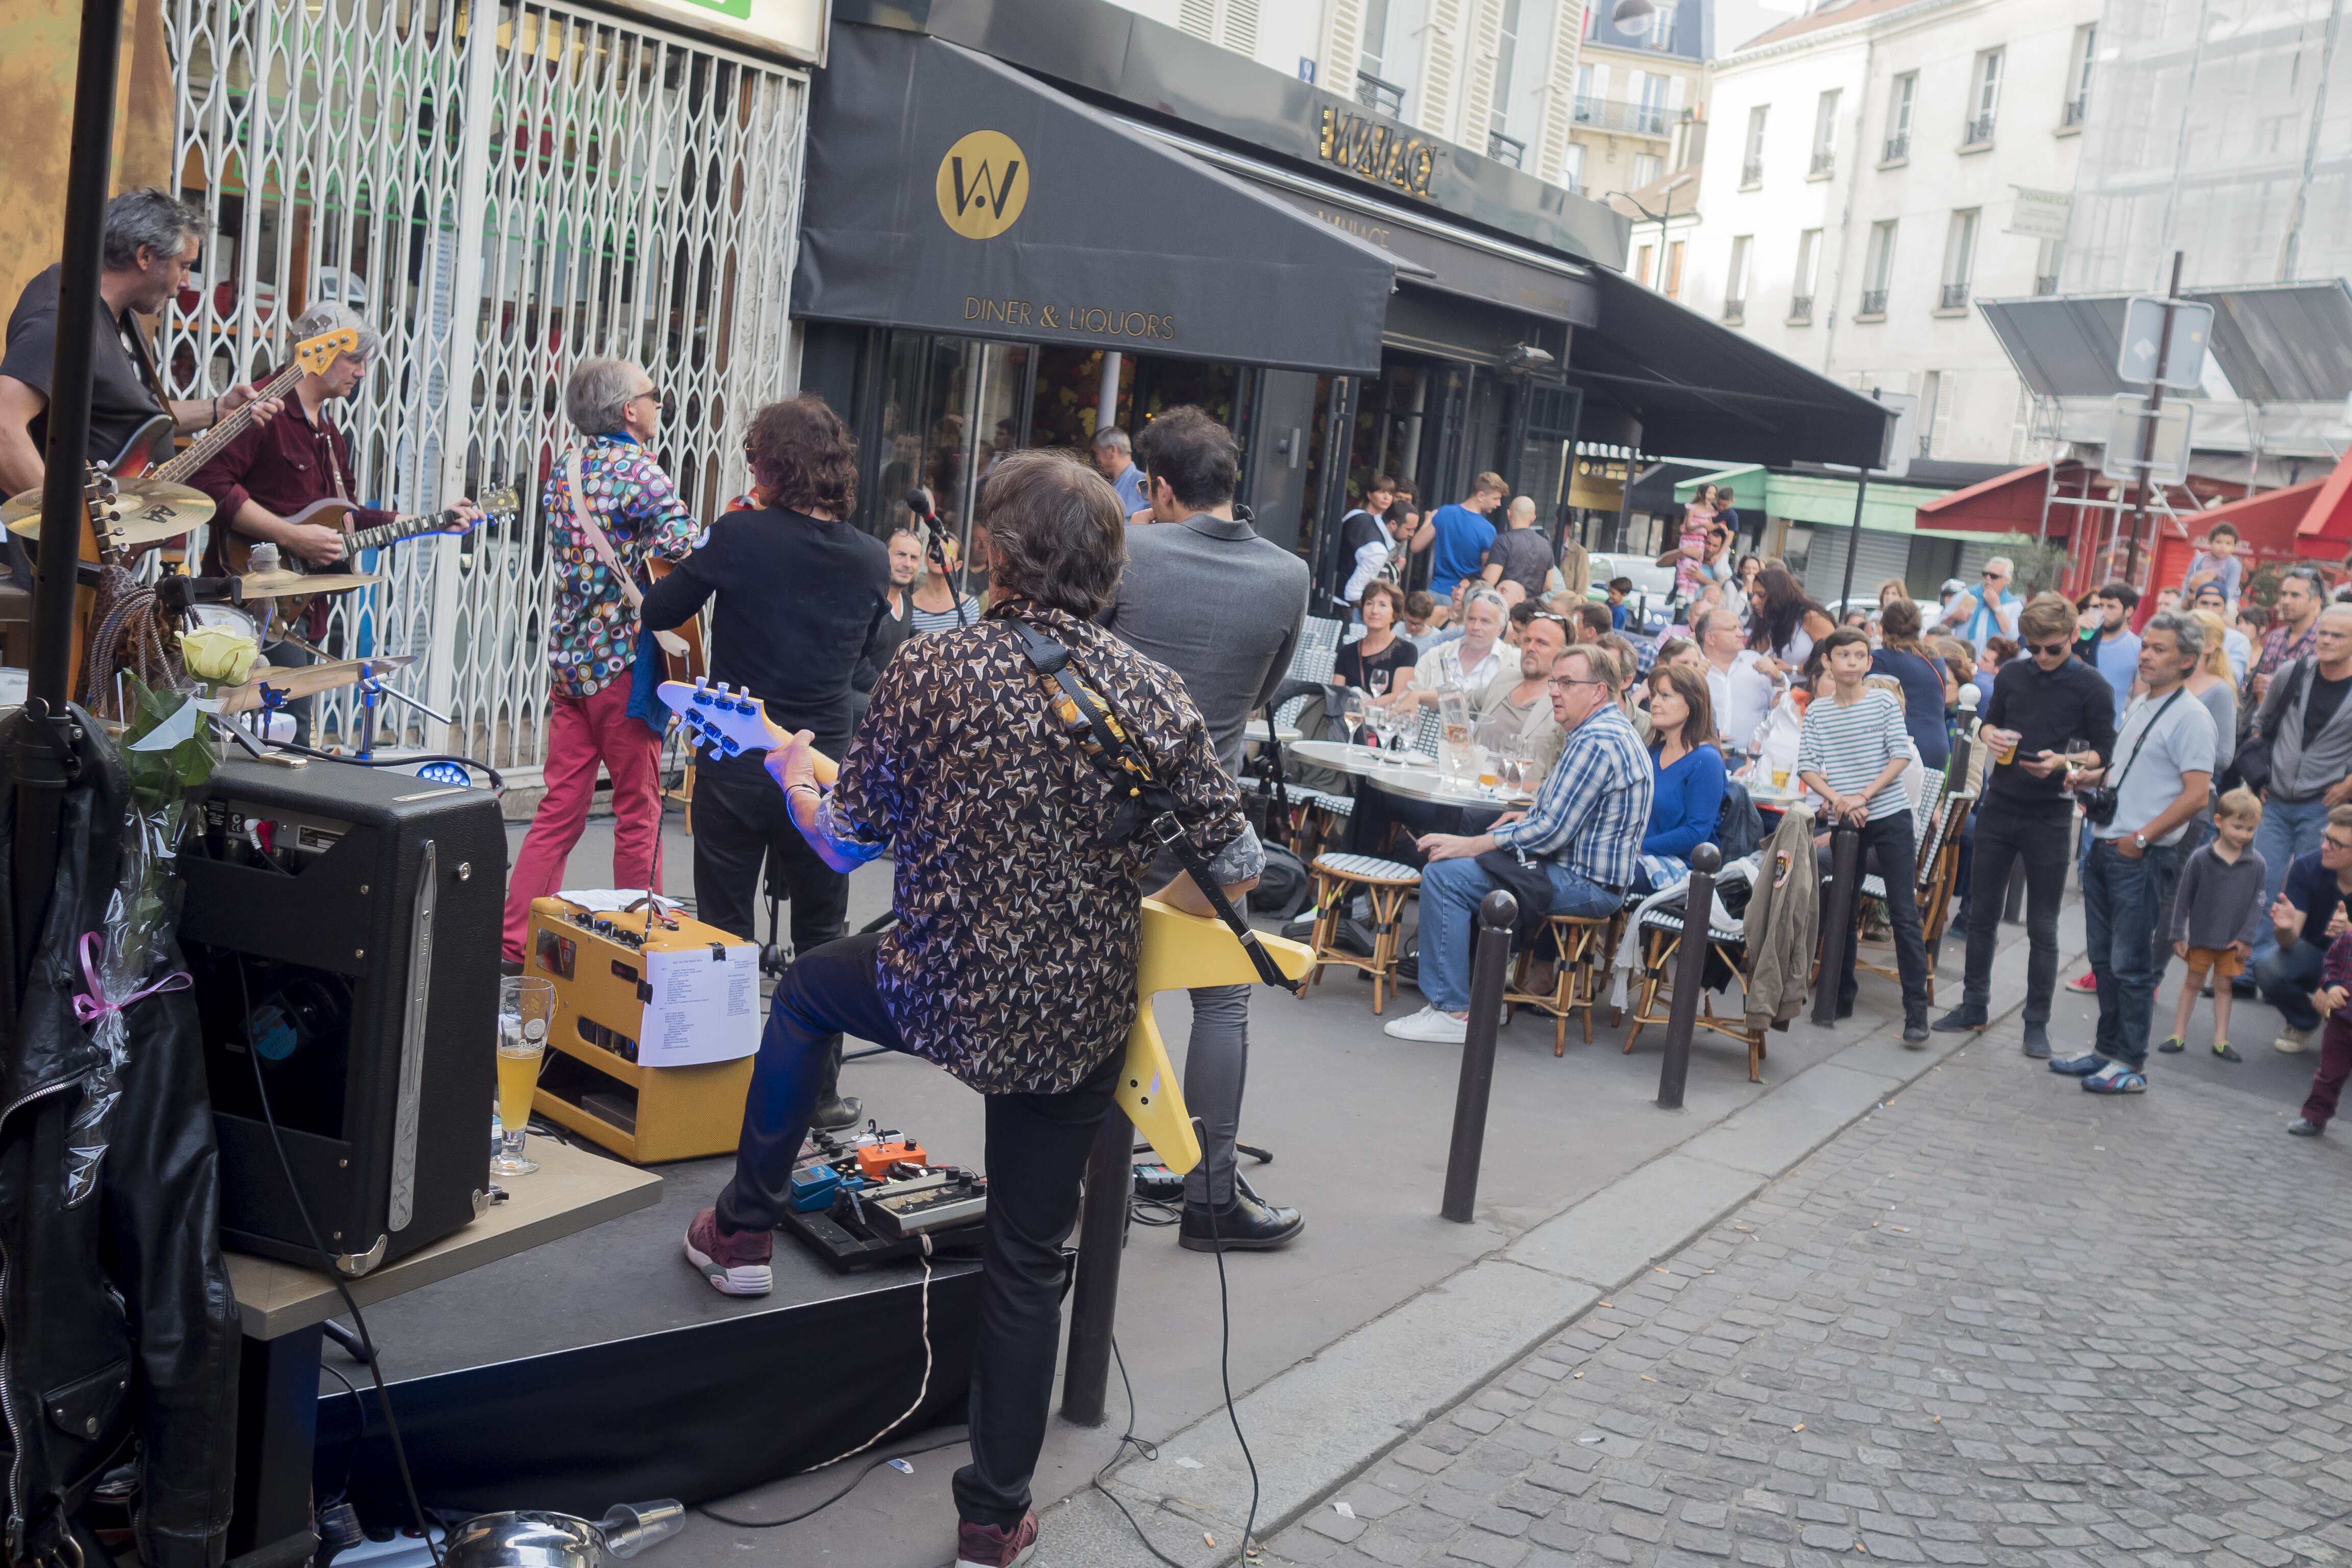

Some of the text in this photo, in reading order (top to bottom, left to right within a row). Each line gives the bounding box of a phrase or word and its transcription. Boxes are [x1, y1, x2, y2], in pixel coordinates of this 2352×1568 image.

[964, 297, 1175, 340] DINER & LIQUORS
